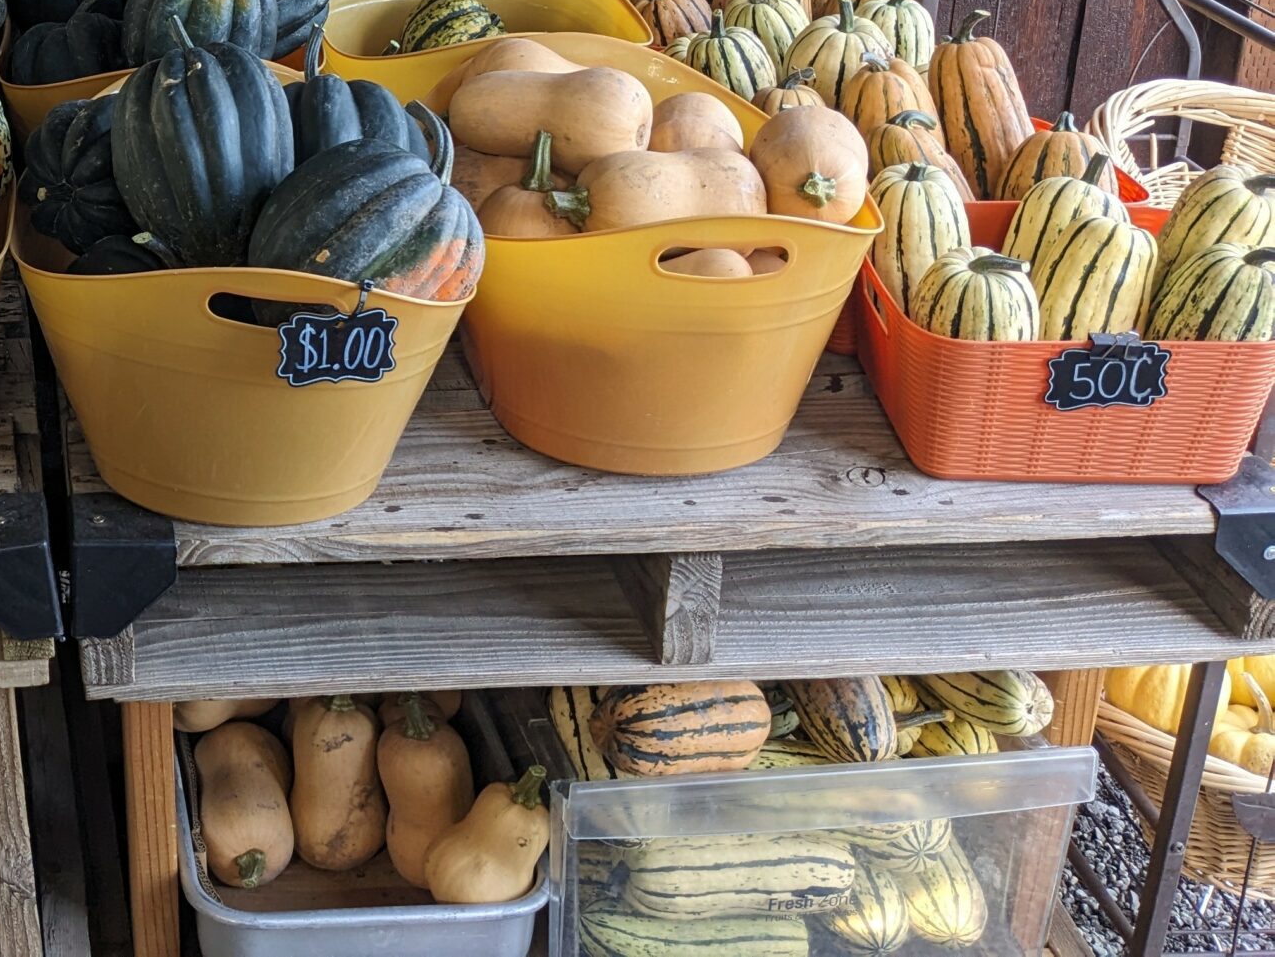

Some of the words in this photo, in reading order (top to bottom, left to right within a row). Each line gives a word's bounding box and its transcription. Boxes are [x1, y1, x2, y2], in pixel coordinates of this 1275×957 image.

[297, 326, 386, 374] $1.00
[768, 898, 813, 911] Fresh
[818, 894, 857, 907] Zone
